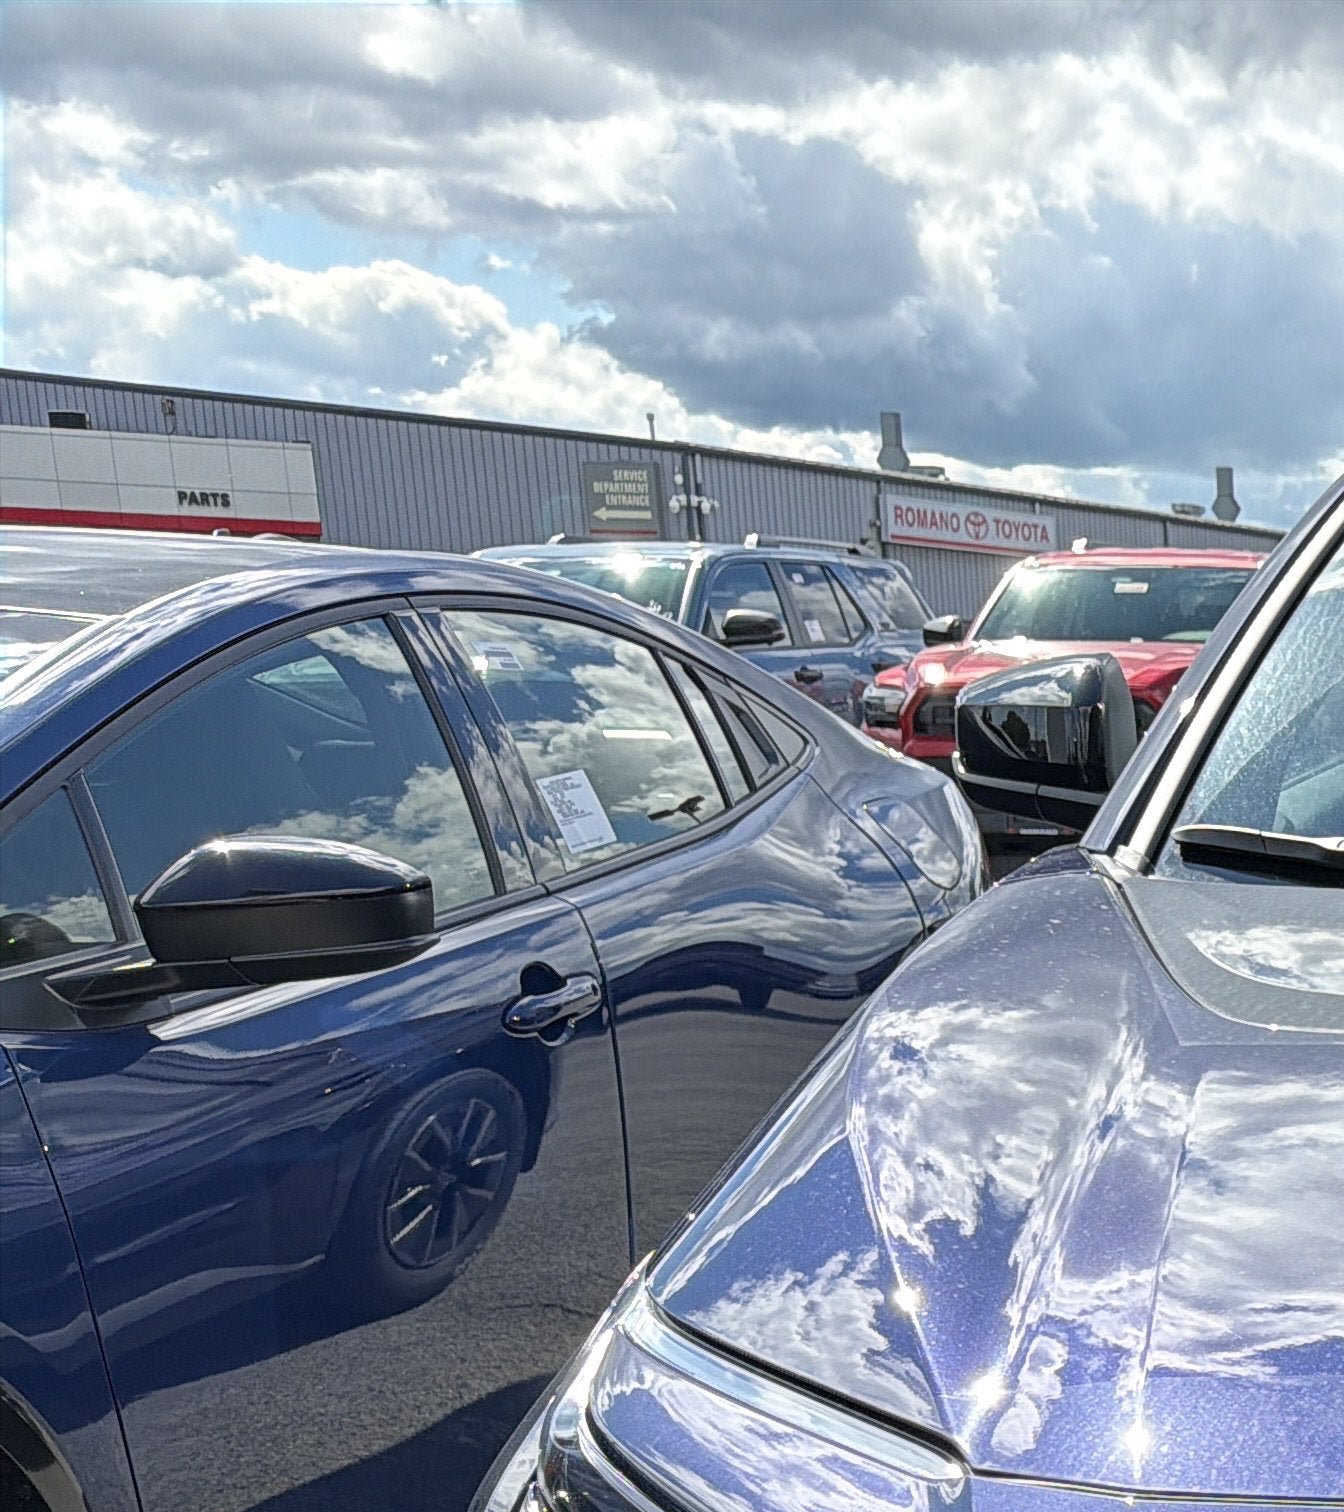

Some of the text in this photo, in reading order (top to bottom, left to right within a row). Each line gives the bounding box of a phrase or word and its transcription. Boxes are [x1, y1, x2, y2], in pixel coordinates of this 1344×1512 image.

[613, 469, 649, 482] SERVICE
[593, 481, 649, 494] DEPARTMENT
[177, 490, 231, 508] PARTS
[605, 494, 650, 507] ENTRANCE
[894, 504, 1050, 543] ROMANO TOYOTA
